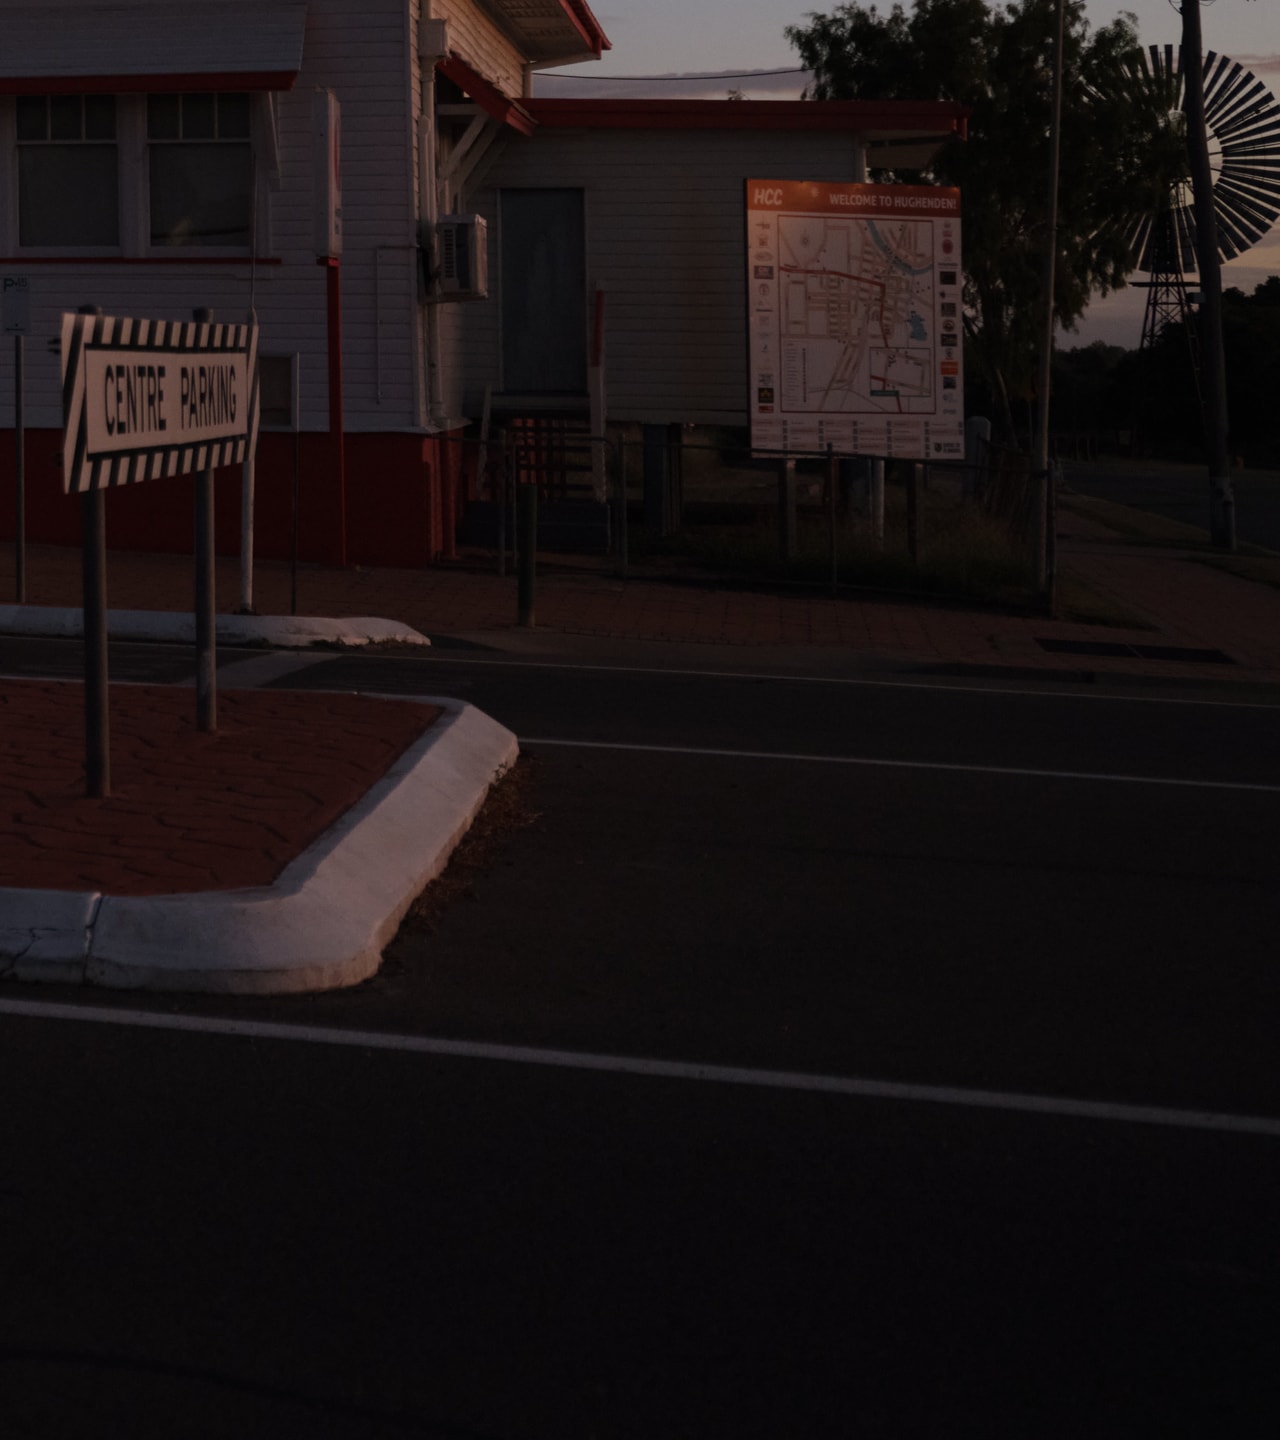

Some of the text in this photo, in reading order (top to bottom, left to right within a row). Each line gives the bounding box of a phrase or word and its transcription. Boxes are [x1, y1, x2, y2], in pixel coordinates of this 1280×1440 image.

[753, 188, 958, 210] HCC WELCOME TO HUGHENDEN!
[104, 364, 237, 436] CENTRE PARKING
